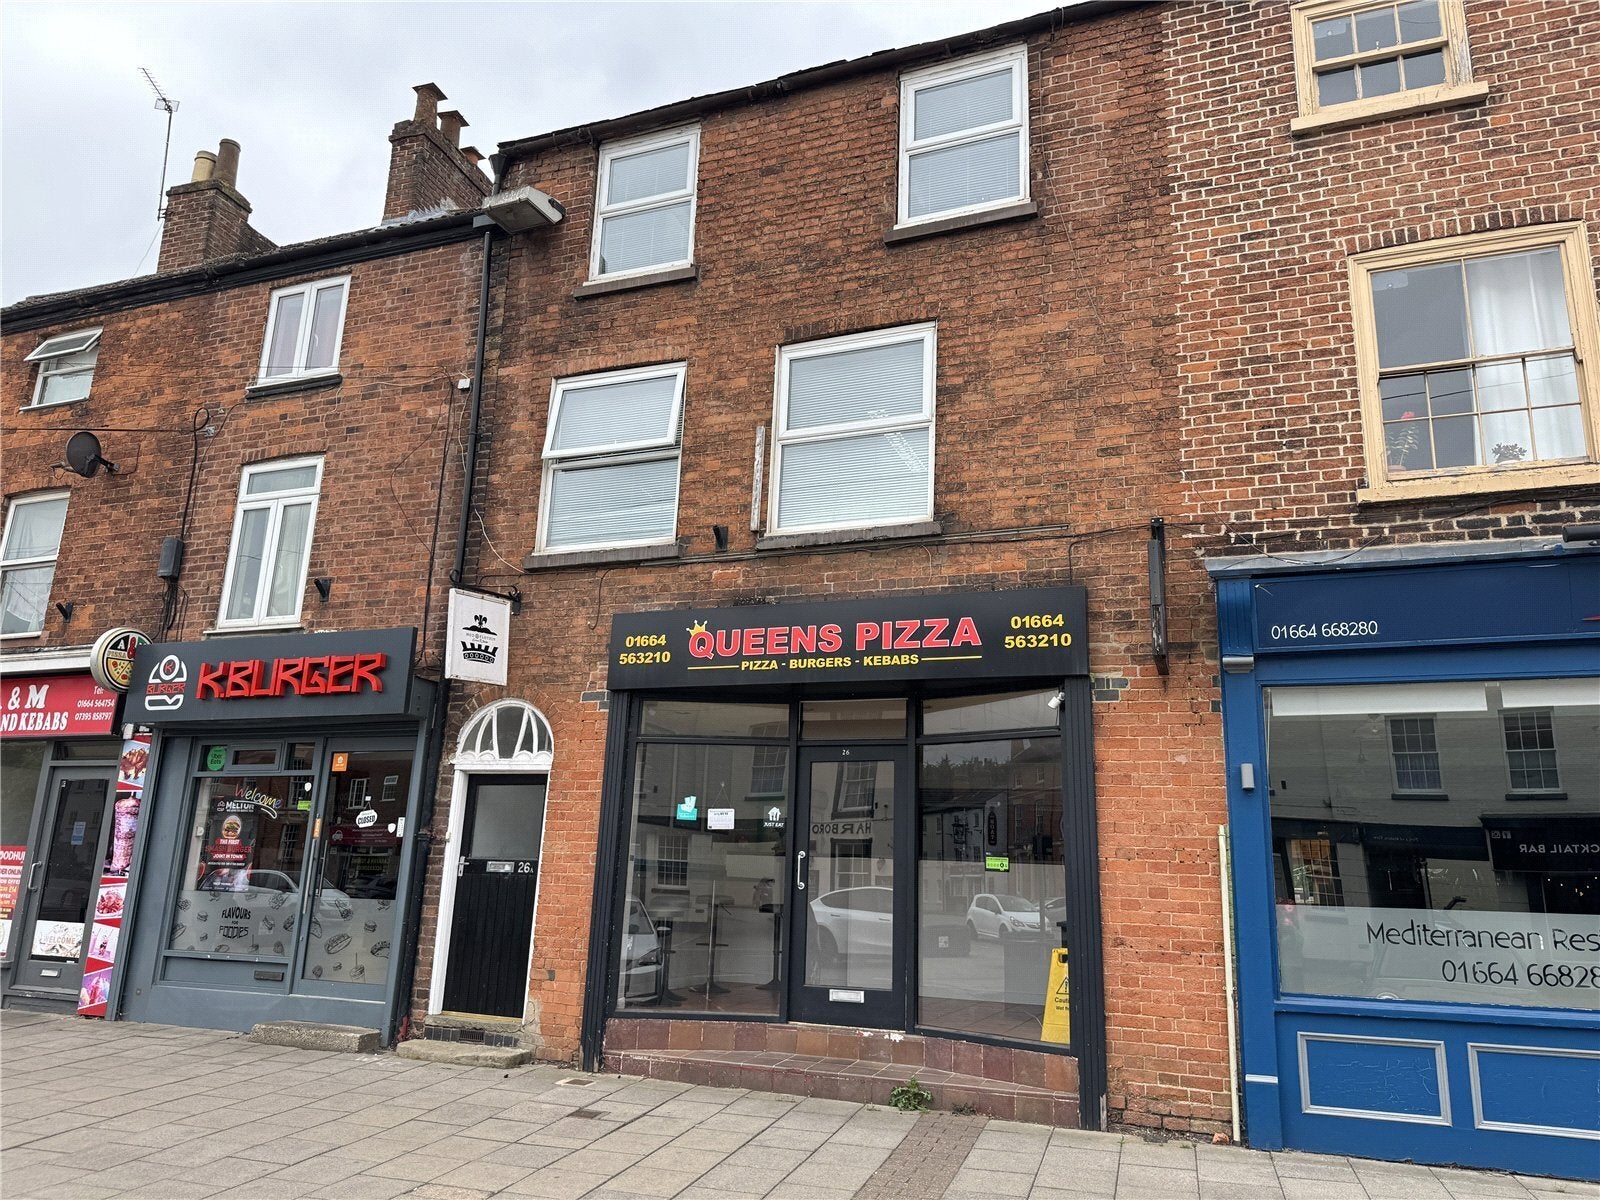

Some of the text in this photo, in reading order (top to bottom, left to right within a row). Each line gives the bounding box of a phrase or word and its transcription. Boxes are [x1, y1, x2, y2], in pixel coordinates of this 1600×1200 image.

[1011, 614, 1064, 629] 01664
[688, 616, 982, 660] QUEENS PIZZA
[1271, 620, 1379, 640] 01664 668280
[117, 639, 126, 650] A
[625, 634, 667, 647] 01664
[1004, 633, 1072, 649] 563210
[619, 651, 671, 665] 563210
[741, 660, 779, 671] PIZZA
[789, 656, 852, 669] BURGERS
[863, 654, 919, 666] KEBABS
[8, 686, 20, 710] &
[24, 684, 50, 709] M
[146, 683, 186, 695] BURGER
[77, 699, 94, 708] 01664
[18, 712, 68, 731] KEBABS
[235, 783, 282, 808] Welcome
[221, 906, 251, 920] FLAVOURS
[1366, 919, 1545, 950] Mediterranean
[1442, 959, 1519, 985] 01664
